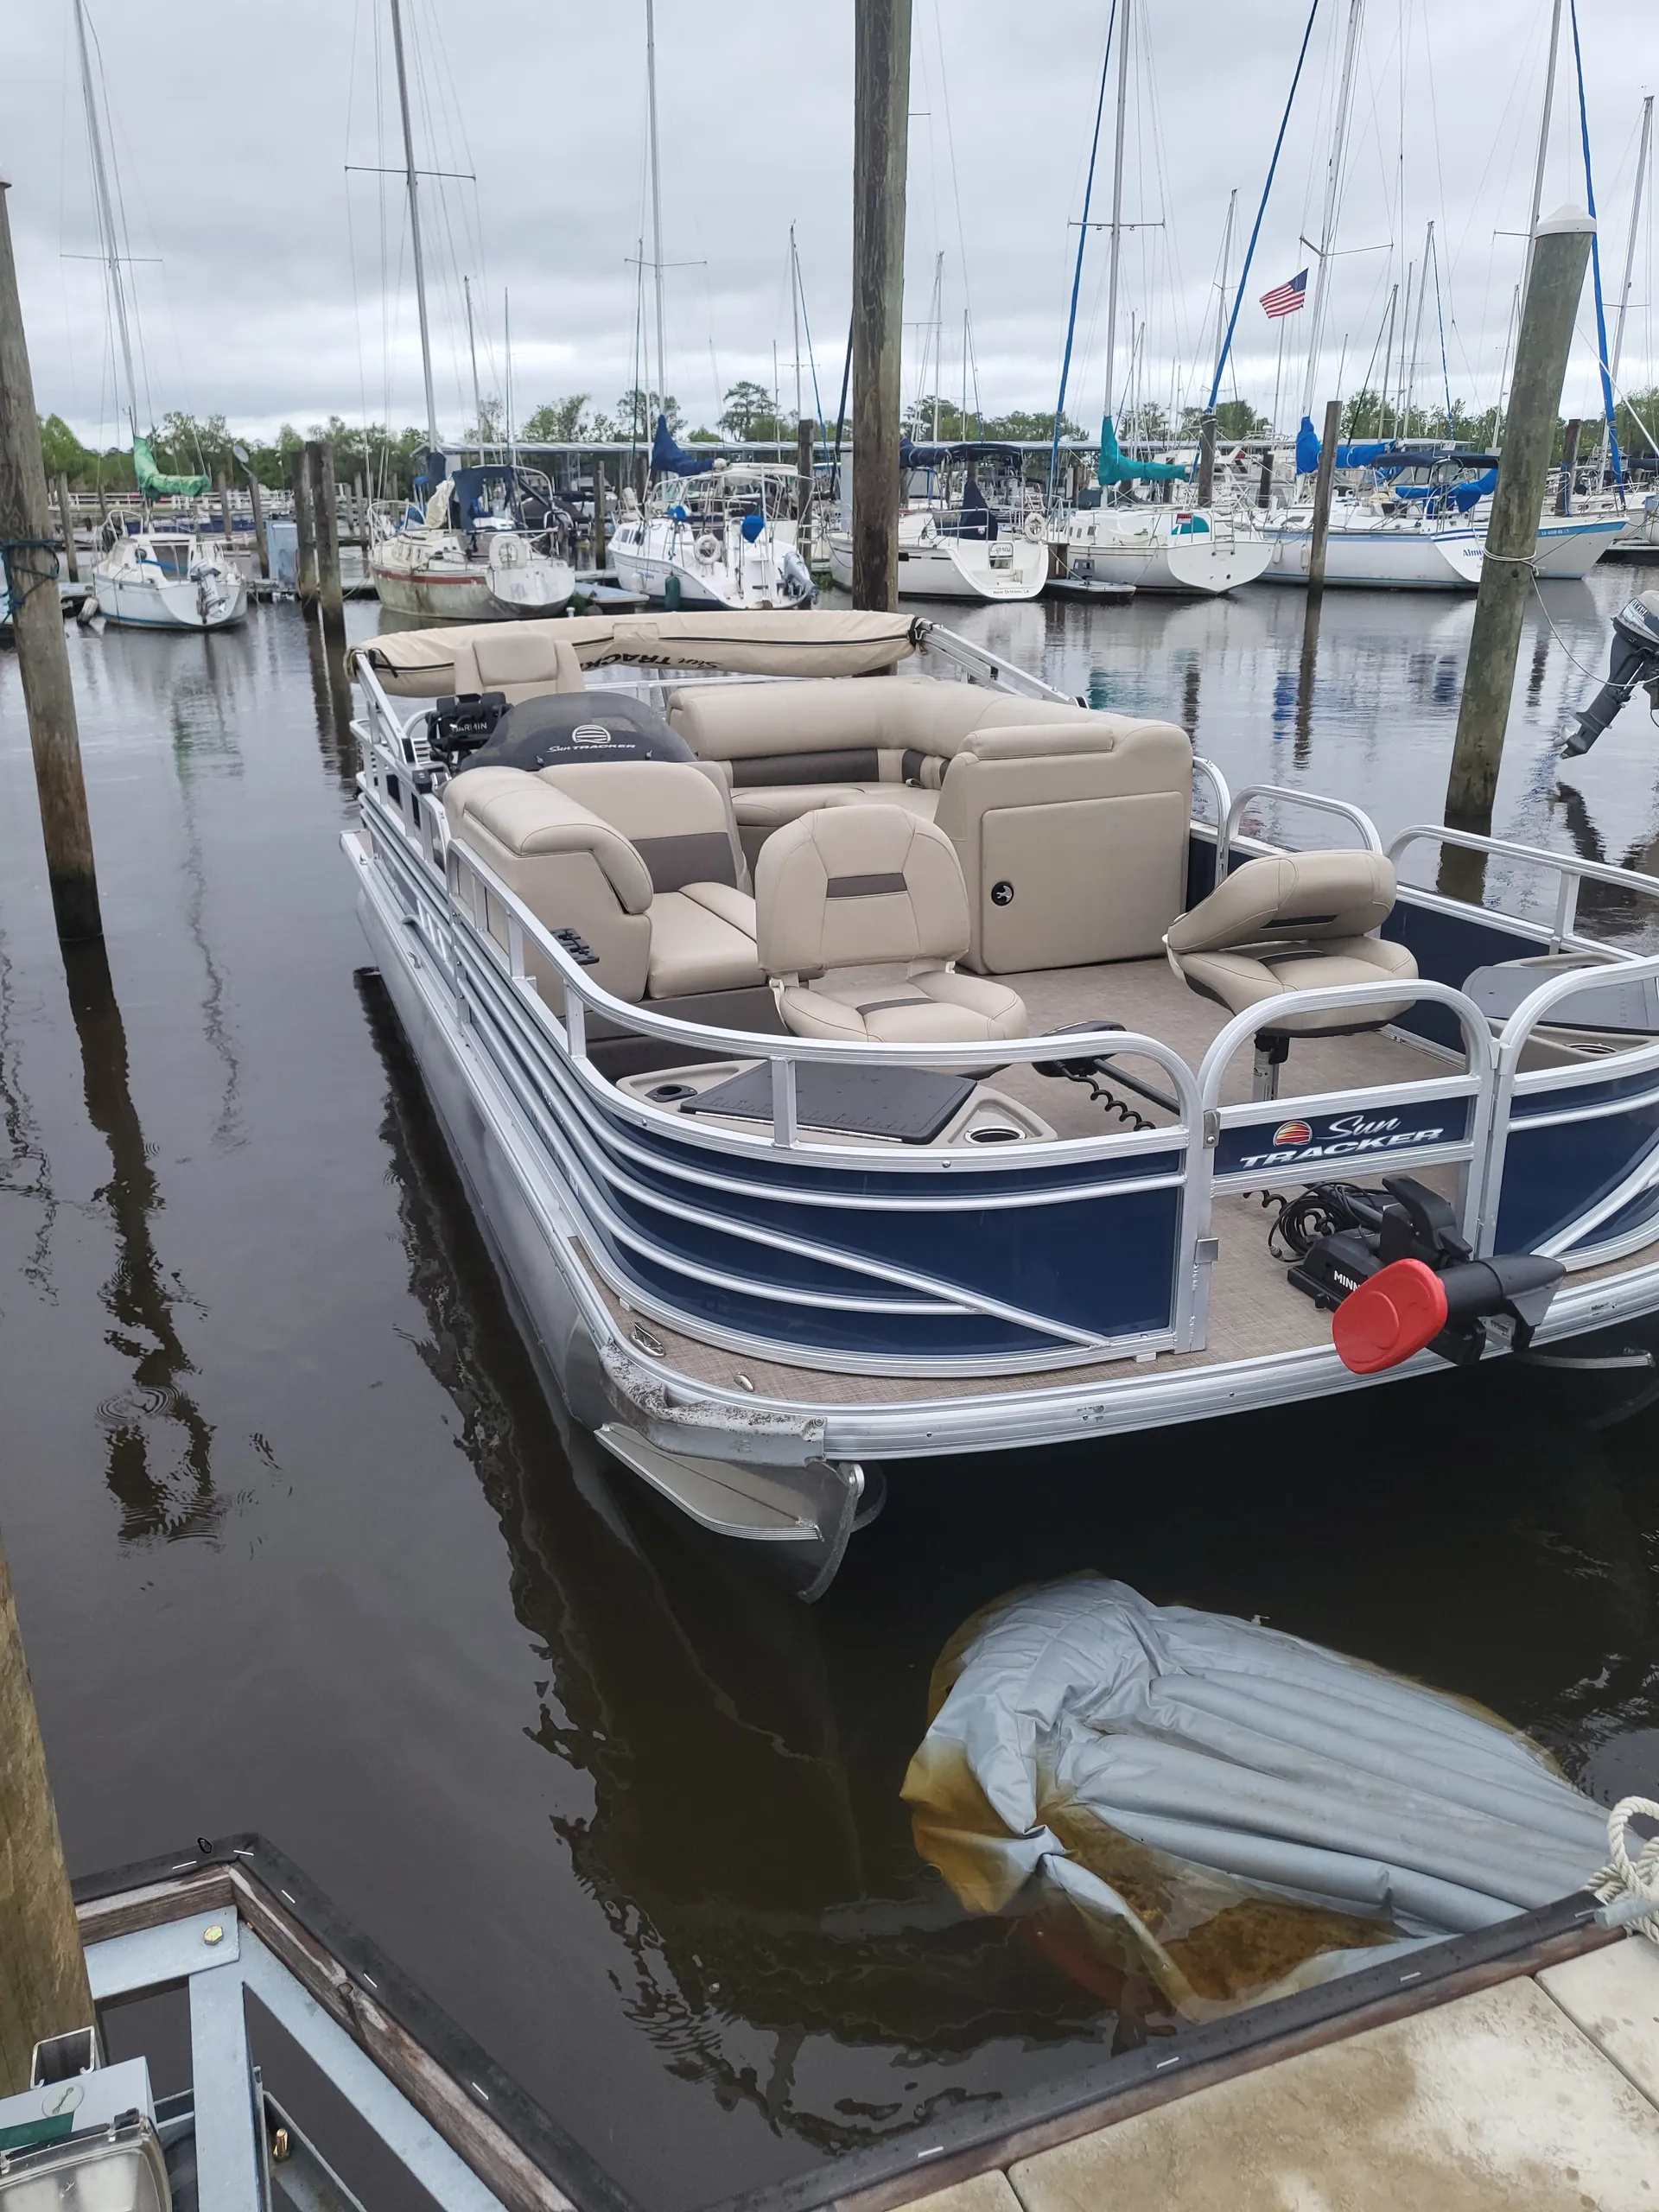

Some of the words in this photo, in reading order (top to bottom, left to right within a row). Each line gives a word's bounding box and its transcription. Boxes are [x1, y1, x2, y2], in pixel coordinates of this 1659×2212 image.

[580, 653, 671, 671] TRACK
[1316, 1115, 1402, 1141] Sun
[1239, 1128, 1445, 1169] TRACKER
